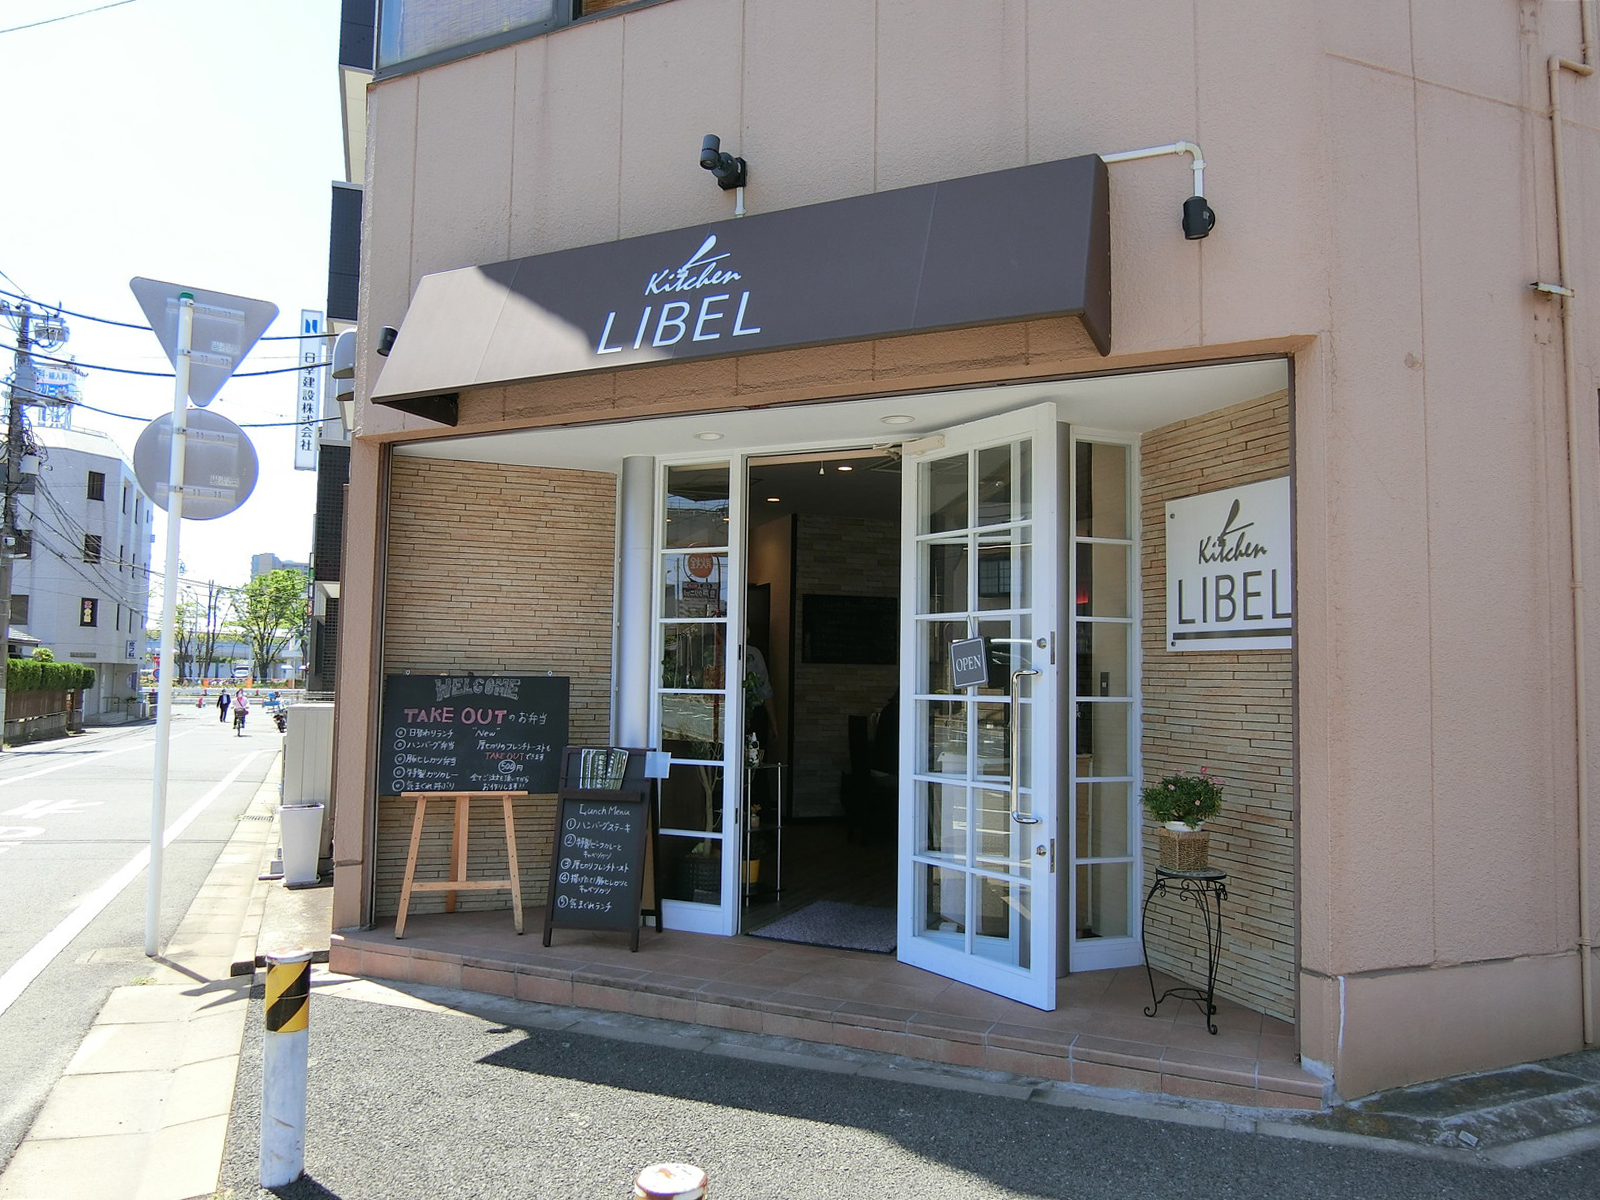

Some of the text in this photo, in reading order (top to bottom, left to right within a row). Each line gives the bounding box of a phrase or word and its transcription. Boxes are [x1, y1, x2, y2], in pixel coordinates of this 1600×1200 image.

[645, 261, 742, 297] Kitchen
[597, 291, 762, 355] LIBEL
[1199, 531, 1268, 565] Kitchen
[1178, 568, 1293, 625] LIBEL
[956, 655, 982, 672] OPEN
[435, 678, 521, 702] WELCOME
[404, 707, 454, 724] TAKE
[461, 707, 507, 724] OUT
[579, 804, 631, 816] Lunch Menu
